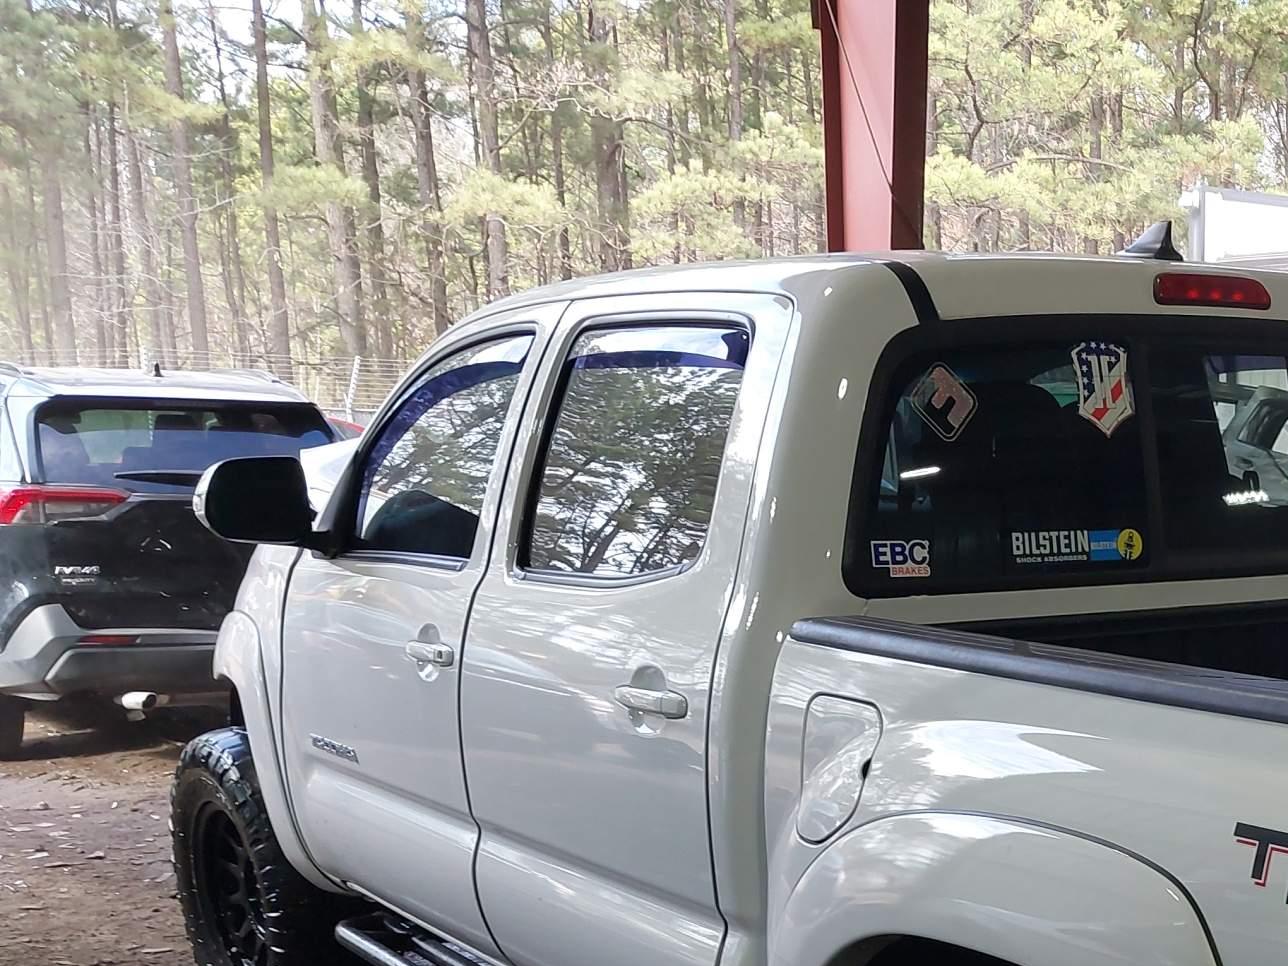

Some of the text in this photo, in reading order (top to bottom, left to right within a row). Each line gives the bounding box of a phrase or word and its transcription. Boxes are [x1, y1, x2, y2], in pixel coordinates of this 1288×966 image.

[1011, 530, 1090, 555] BILSTEIN
[873, 542, 928, 566] EBC
[1016, 554, 1087, 564] SHOCK ABSORBERS
[891, 566, 929, 576] BRAKES
